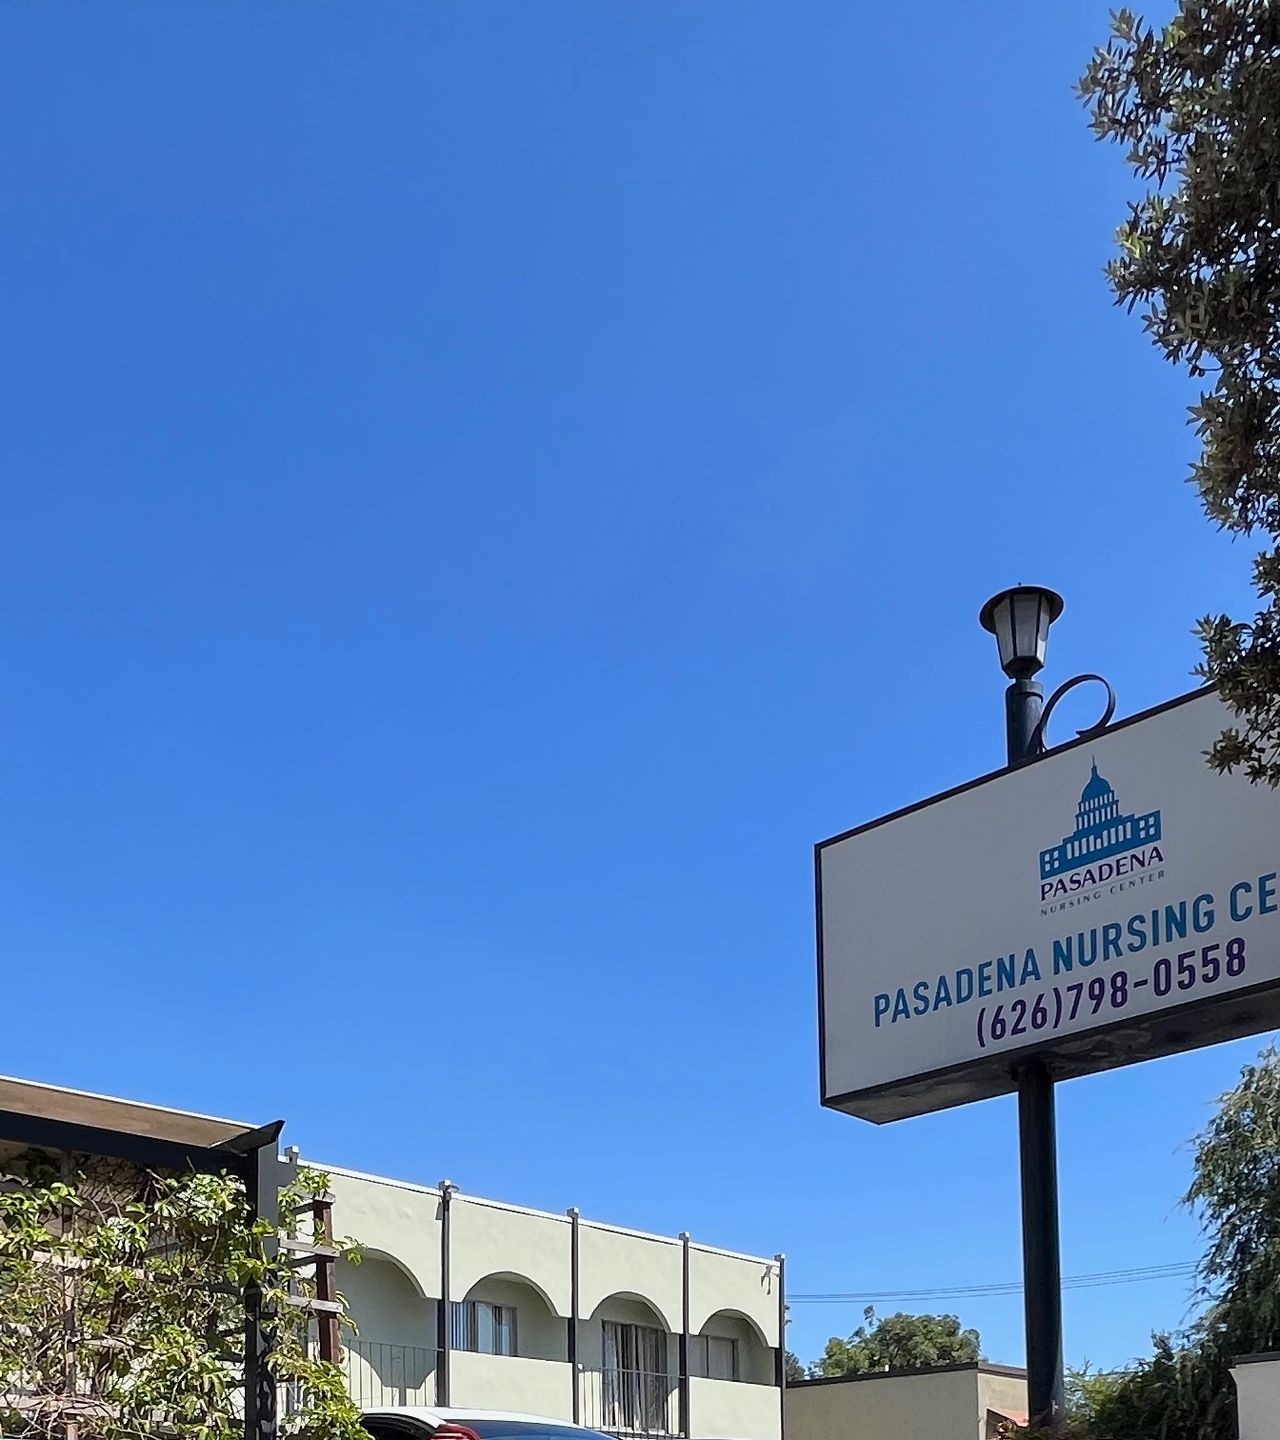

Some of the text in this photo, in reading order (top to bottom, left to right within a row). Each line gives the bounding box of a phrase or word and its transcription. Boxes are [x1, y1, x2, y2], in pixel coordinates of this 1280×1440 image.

[1040, 846, 1163, 901] PASADENA
[1040, 870, 1165, 917] NURSING CENTER
[874, 948, 1041, 1028] PASADENA
[1053, 893, 1215, 976] NURSING
[977, 937, 1246, 1048] (626)798-0558
